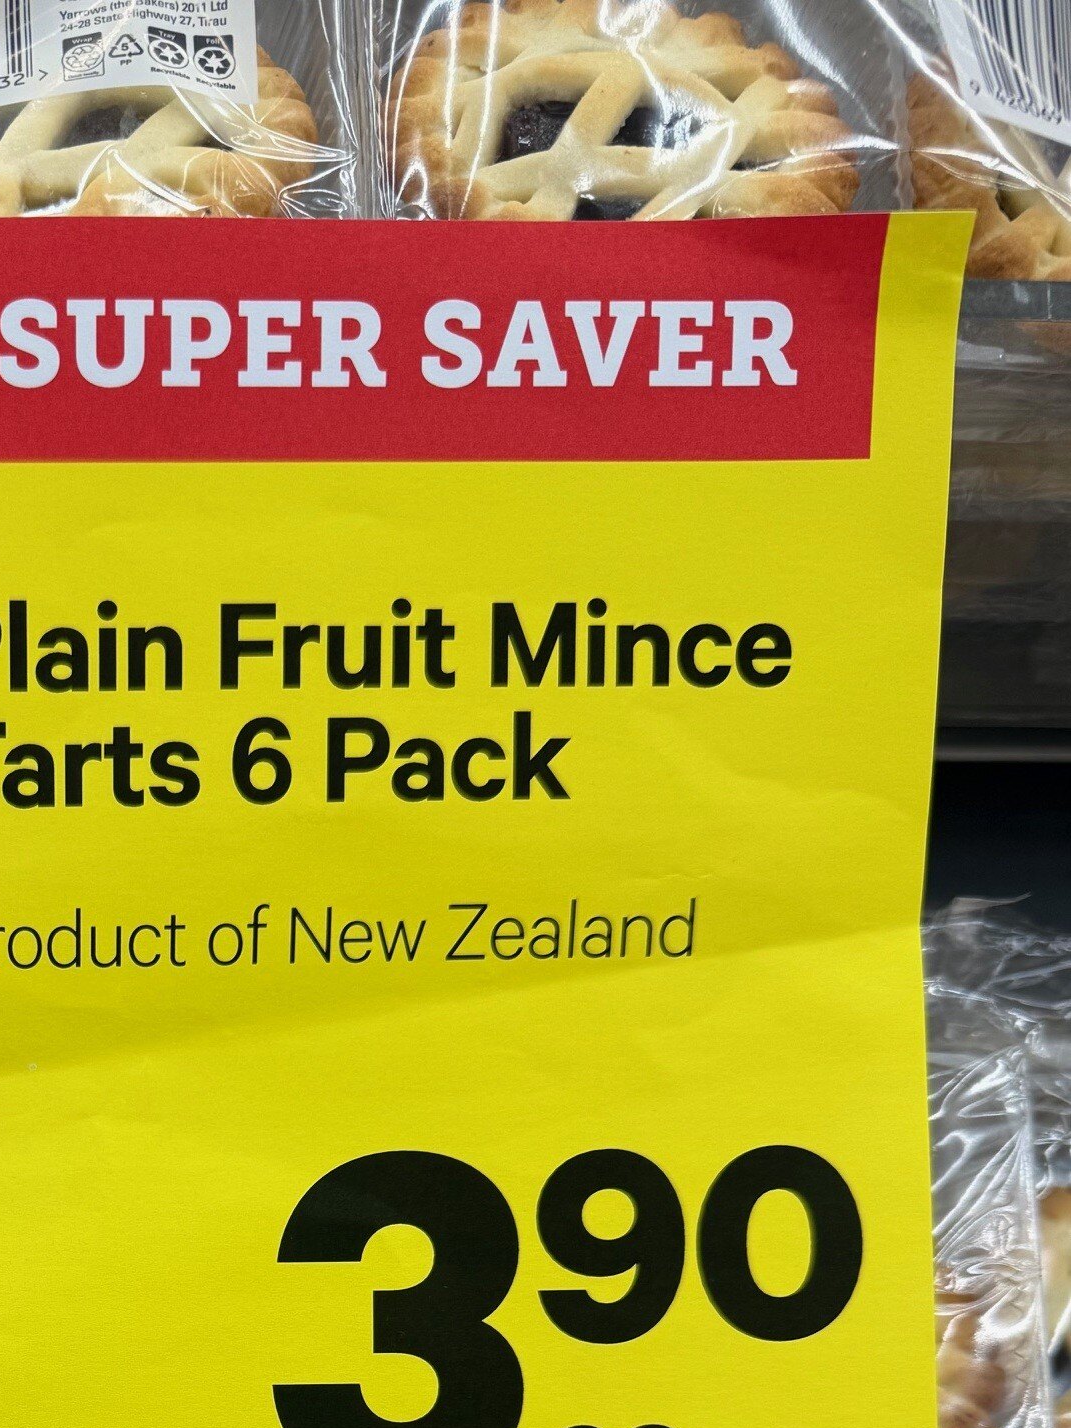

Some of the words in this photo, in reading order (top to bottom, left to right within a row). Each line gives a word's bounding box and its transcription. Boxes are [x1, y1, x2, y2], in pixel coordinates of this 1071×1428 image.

[420, 297, 798, 390] SAVER
[219, 597, 457, 693] Fruit
[488, 597, 794, 690] Mince
[231, 716, 294, 806] 6
[325, 710, 571, 805] Pack
[209, 903, 270, 967] of
[288, 905, 428, 965] New
[445, 897, 697, 961] Zealand
